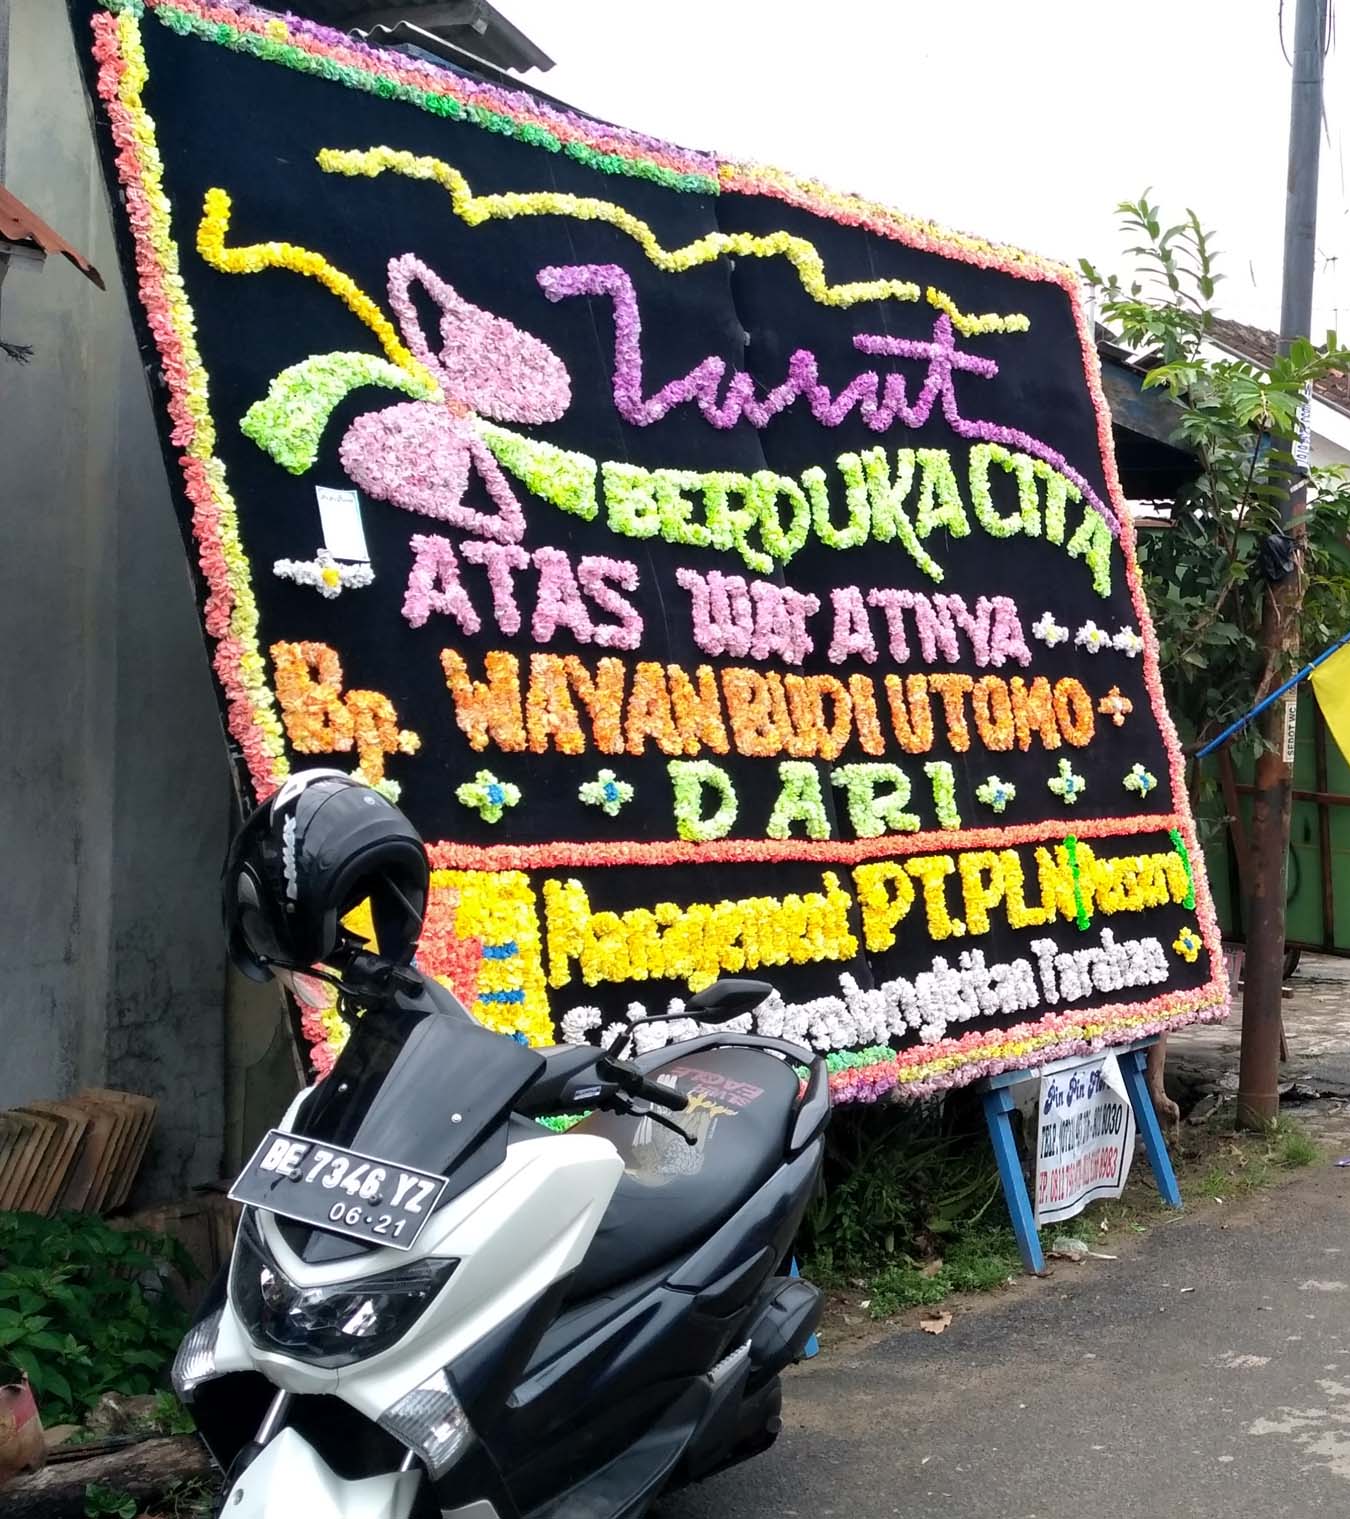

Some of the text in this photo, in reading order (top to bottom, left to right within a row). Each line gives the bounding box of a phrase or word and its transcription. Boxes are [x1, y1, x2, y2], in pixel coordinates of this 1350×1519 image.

[401, 533, 644, 651] ATAS
[667, 757, 962, 844] DARI
[261, 1138, 436, 1215] BE 7346 YZ
